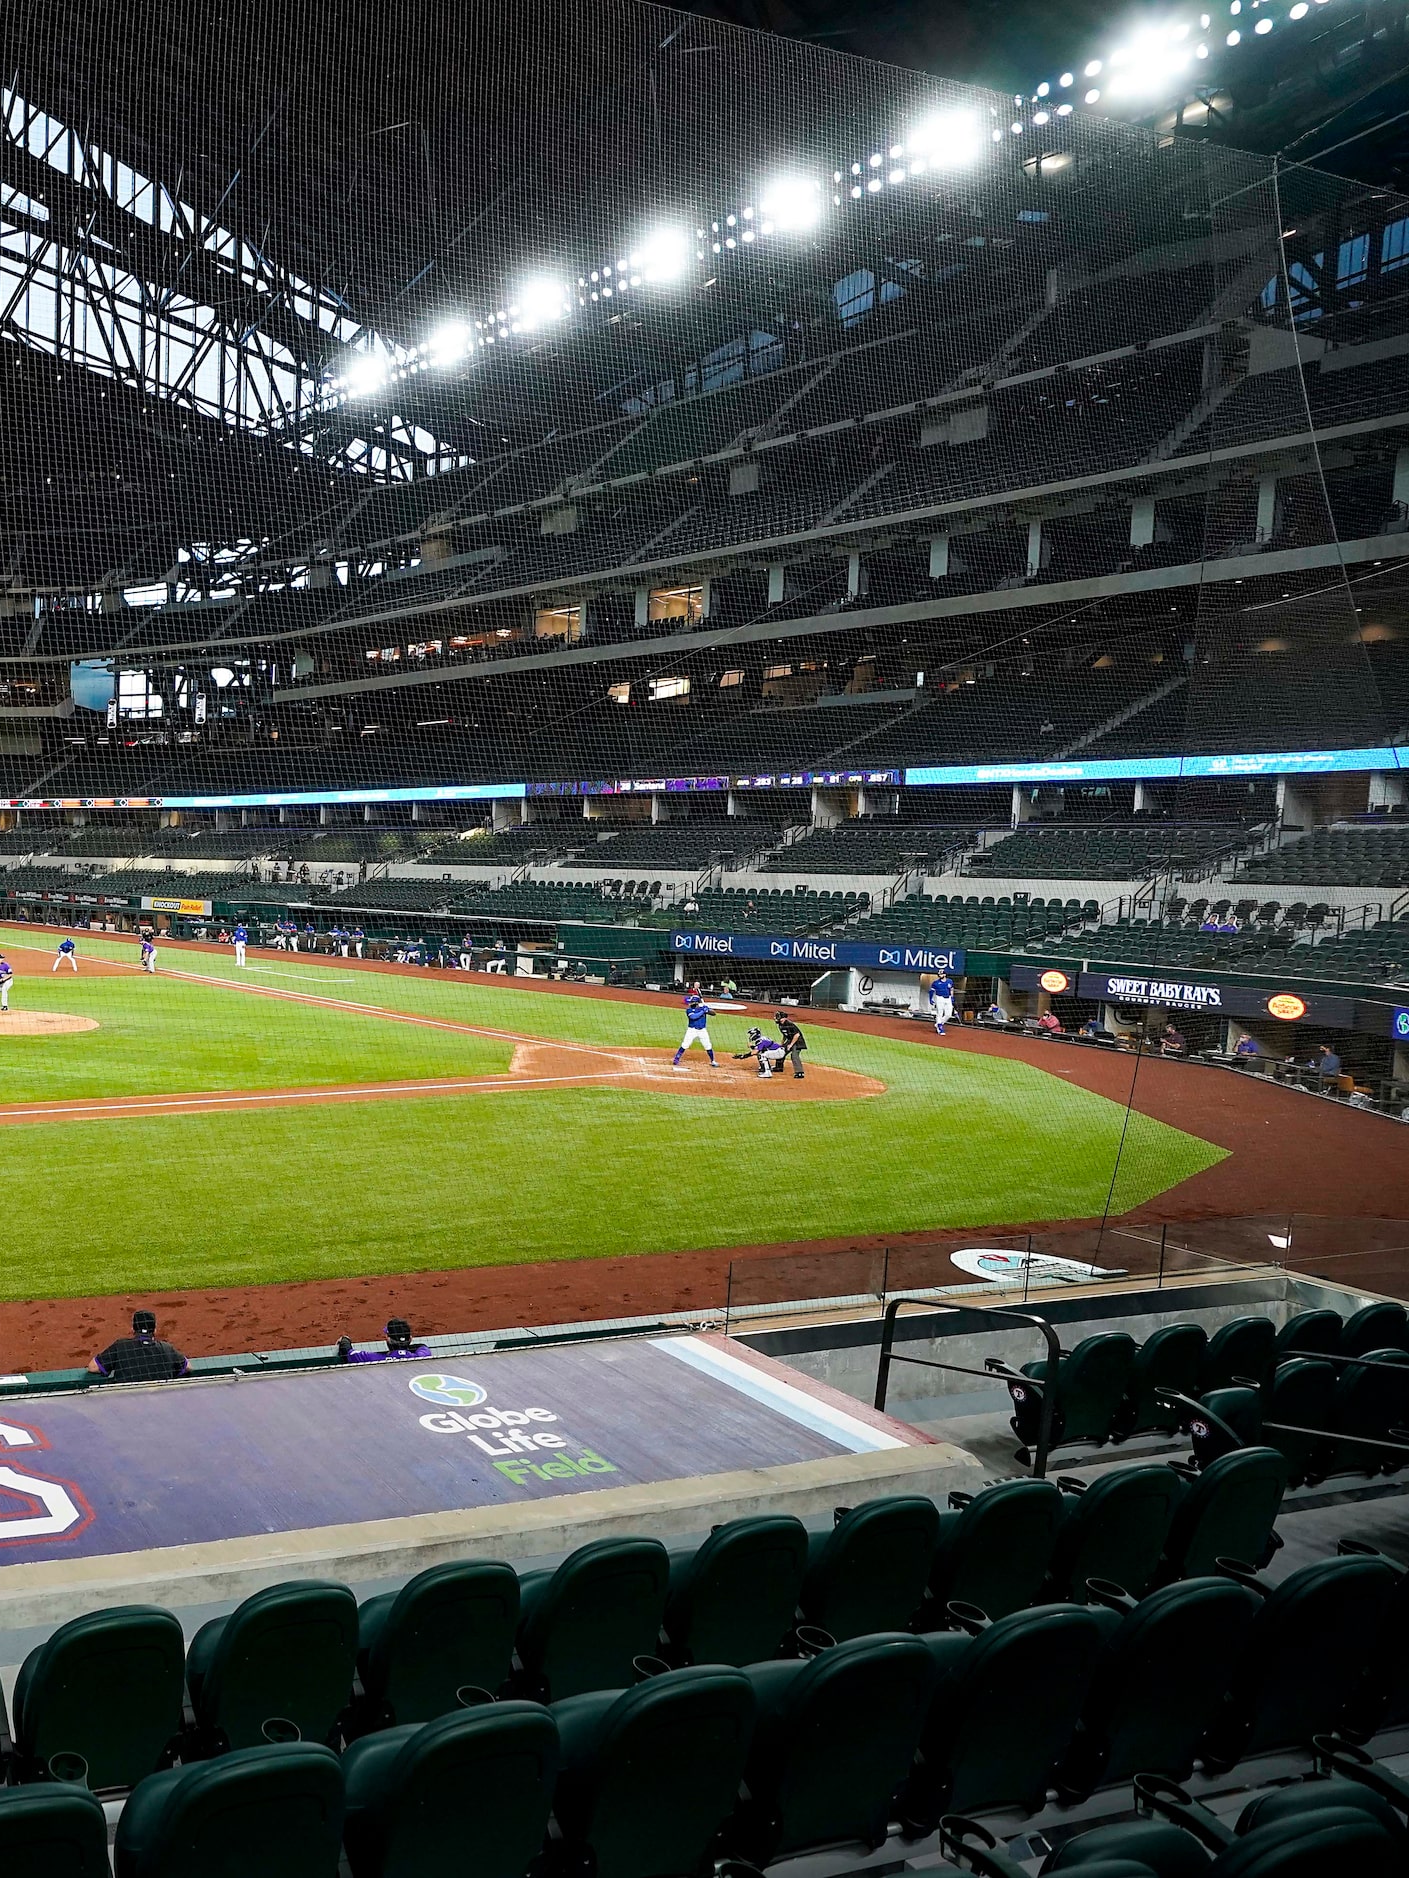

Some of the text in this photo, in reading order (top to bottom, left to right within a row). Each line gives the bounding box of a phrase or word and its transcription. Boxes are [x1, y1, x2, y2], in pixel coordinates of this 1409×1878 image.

[633, 780, 666, 790] Santana
[153, 901, 180, 910] KNOCKOUT
[695, 935, 733, 953] Mitel
[792, 942, 836, 960] Mitel
[905, 949, 955, 970] Mitel
[1107, 978, 1220, 1005] SWEET BABY RAY'S
[418, 1406, 558, 1434] Globe
[467, 1428, 567, 1456] Life
[492, 1448, 620, 1485] Field
